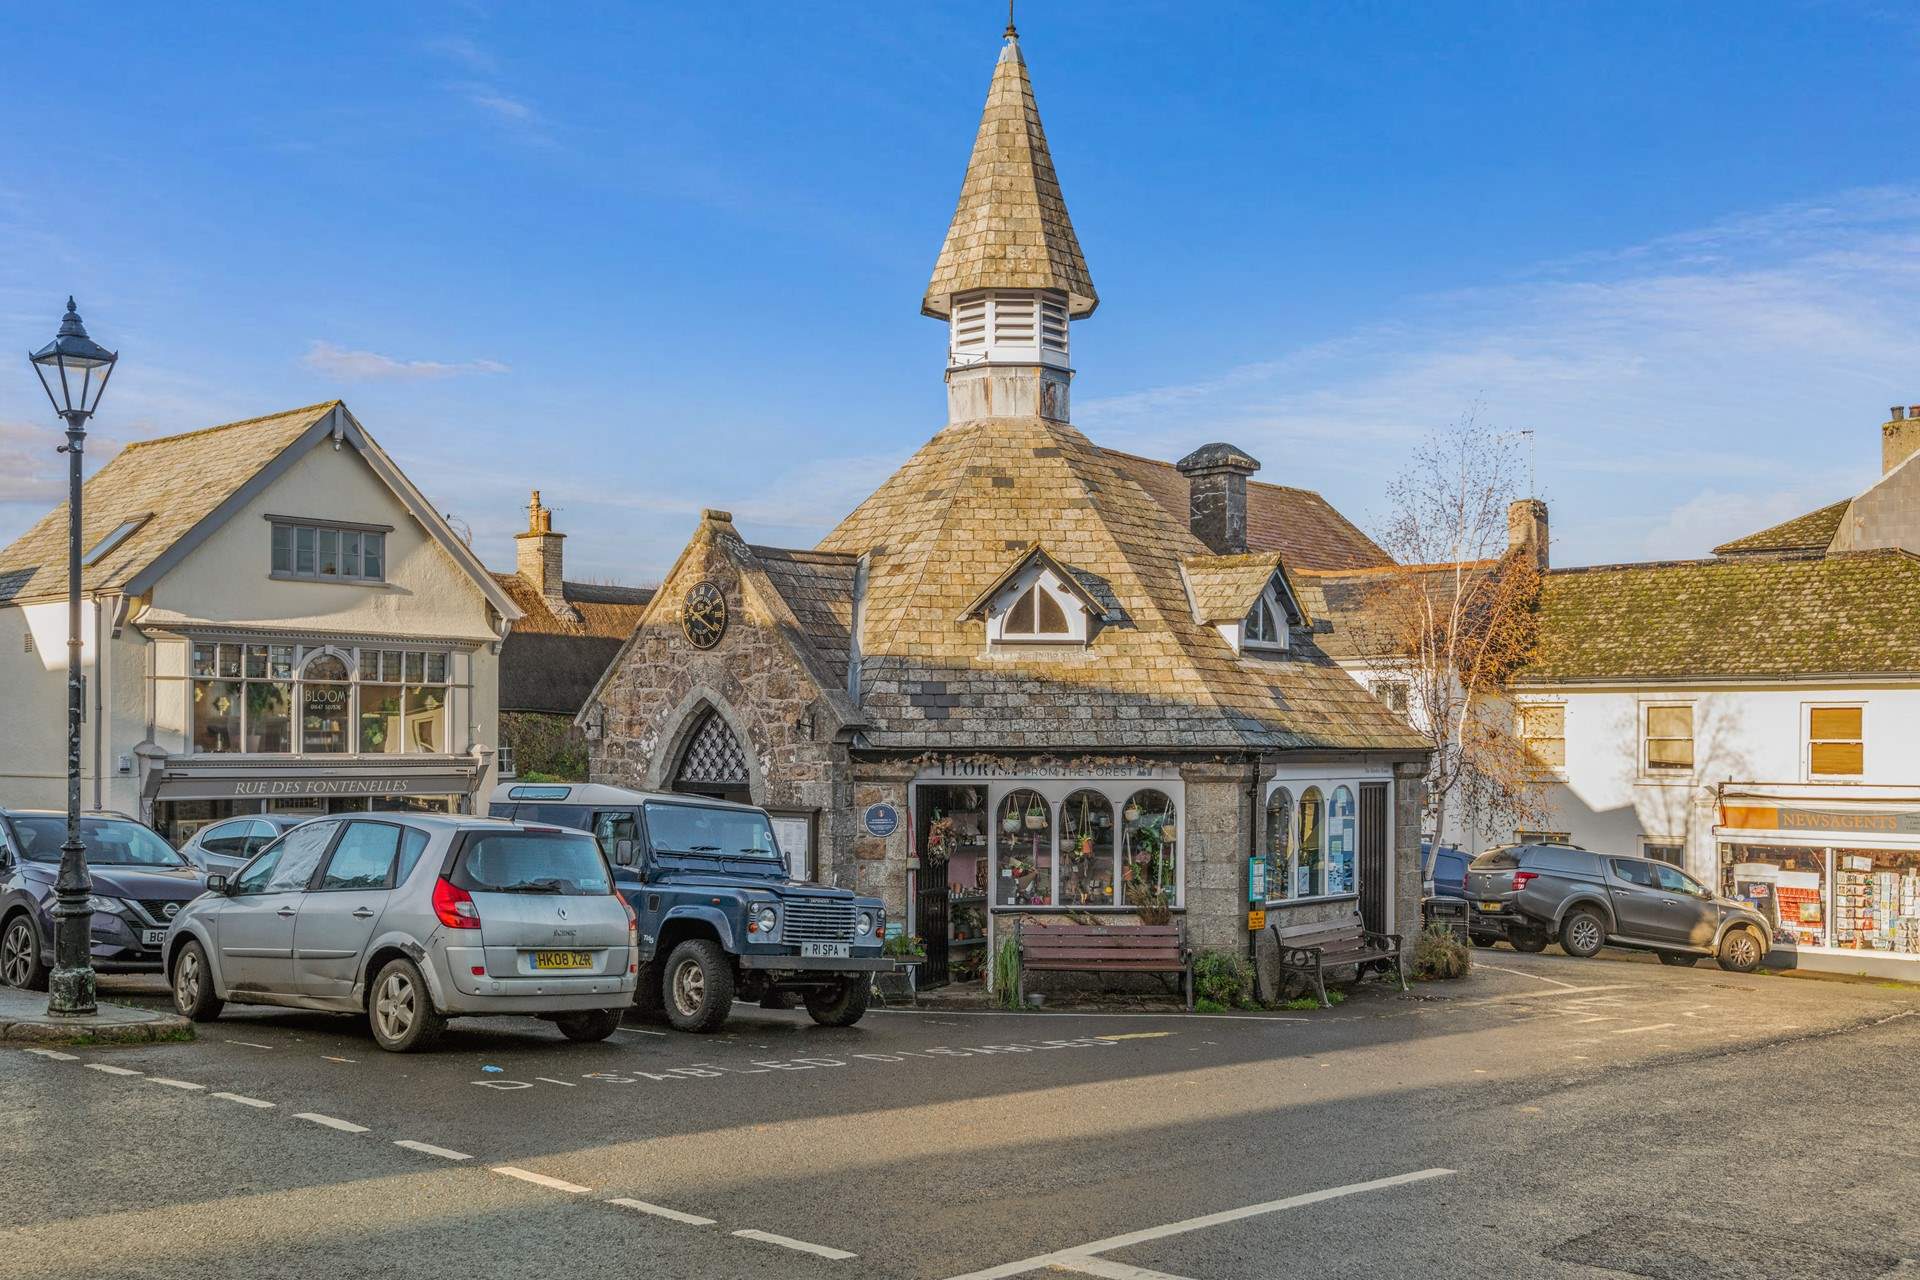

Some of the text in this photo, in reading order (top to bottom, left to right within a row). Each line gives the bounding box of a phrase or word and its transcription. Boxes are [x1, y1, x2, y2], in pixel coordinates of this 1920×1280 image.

[305, 690, 346, 702] BLOOM
[234, 780, 409, 795] RUE DES FONTENELLES
[1783, 813, 1897, 831] NEWSAGENTS
[822, 944, 839, 956] SPA
[538, 951, 592, 967] HK08 XZR
[471, 1037, 1118, 1090] DISABLED DISABLED
